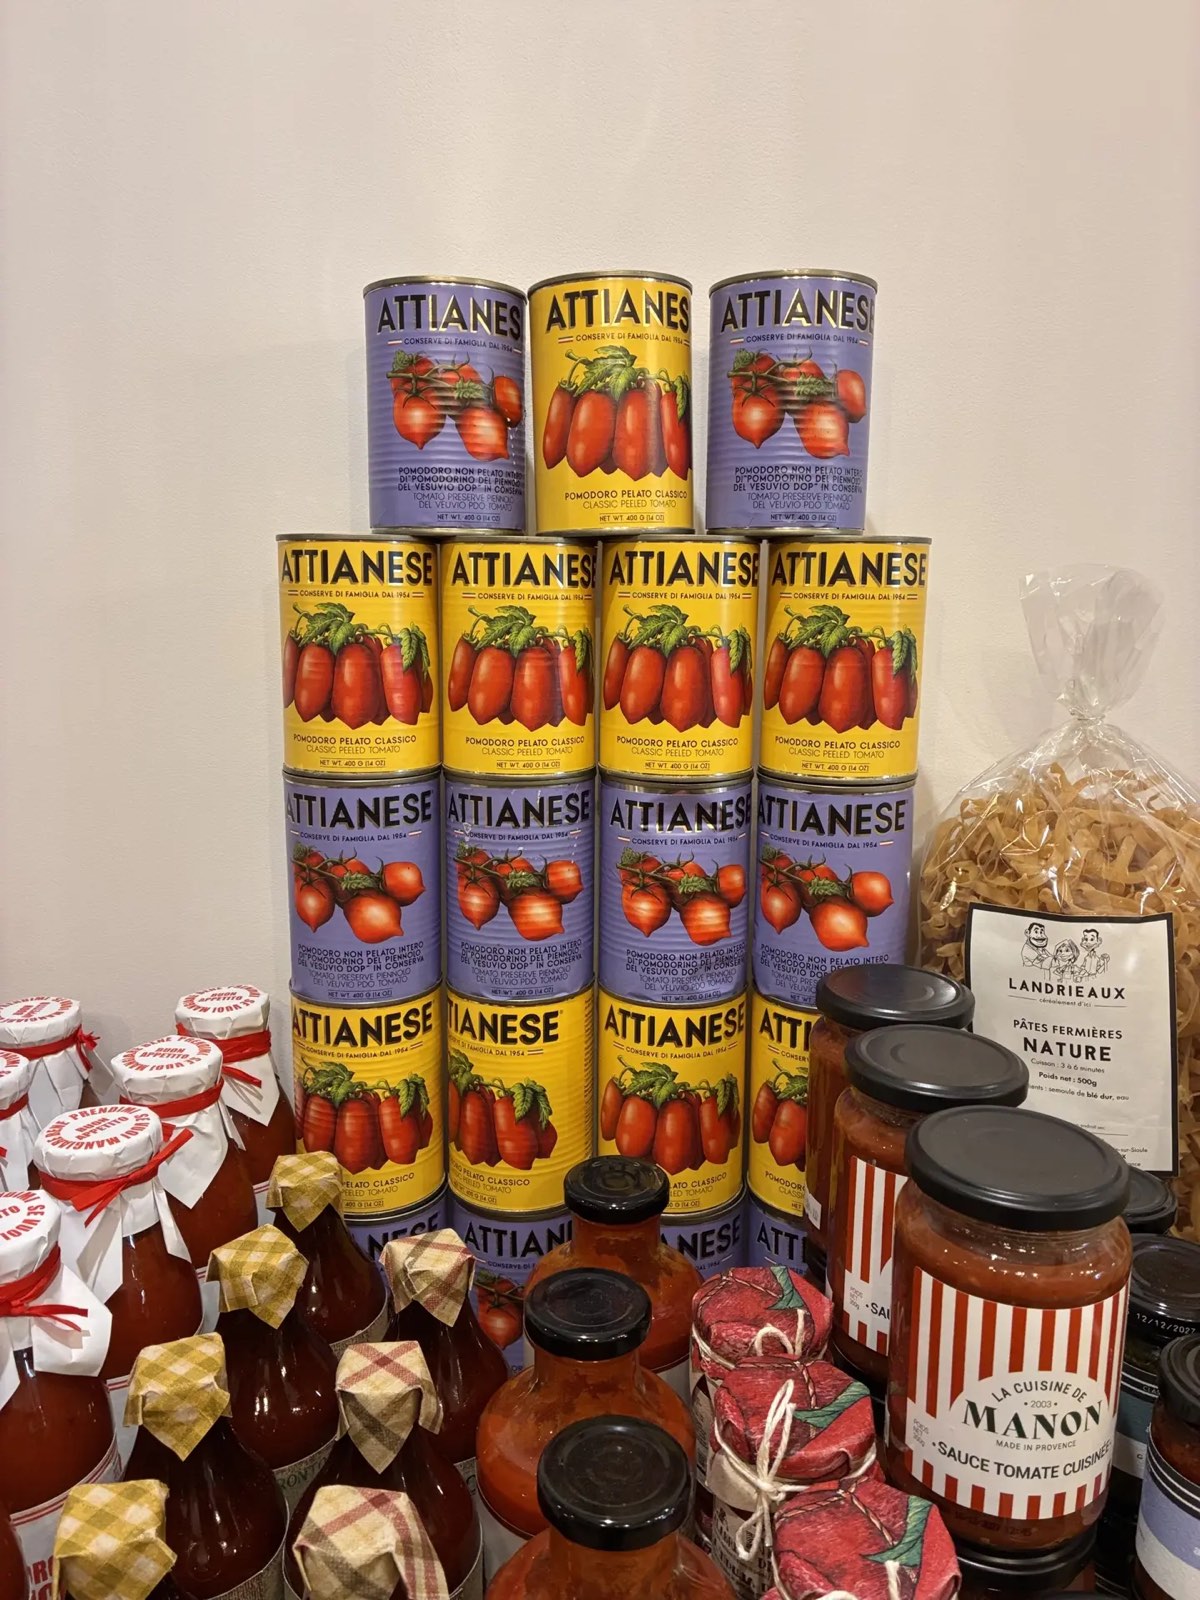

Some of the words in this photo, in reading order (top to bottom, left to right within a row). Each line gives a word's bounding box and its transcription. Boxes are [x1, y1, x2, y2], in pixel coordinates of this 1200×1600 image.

[377, 294, 522, 340] ATTIANES
[545, 288, 690, 334] ATTIANES
[576, 332, 615, 342] CONSERVE
[618, 332, 626, 340] DI
[627, 332, 659, 341] FAMIGLIA
[735, 465, 788, 475] POMODORO
[792, 466, 812, 474] NON
[815, 466, 843, 476] PELATO
[565, 490, 618, 500] POMODORO
[621, 490, 652, 499] PELATO
[655, 490, 688, 500] CLASSICO
[583, 500, 618, 510] CLASSIC
[620, 500, 647, 509] PEELED
[650, 500, 677, 509] TOMATO
[281, 549, 432, 587] ATTIANESE
[608, 550, 759, 588] ATTIANESE
[770, 551, 926, 588] ATTIANESE
[299, 590, 332, 598] CONSERVE
[478, 592, 515, 600] CONSERVE
[632, 592, 668, 600] CONSERVE
[680, 592, 713, 600] FAMIGLIA
[794, 592, 829, 600] CONSERVE
[832, 592, 840, 600] DI
[294, 733, 337, 745] POMODORO
[340, 737, 371, 746] PELATO
[375, 734, 417, 745] CLASSICO
[466, 736, 515, 748] POMODORO
[518, 740, 549, 748] PELATO
[551, 736, 585, 746] CLASSICO
[616, 736, 663, 747] POMODORO
[666, 740, 698, 748] PELATO
[700, 738, 739, 748] CLASSICO
[775, 736, 821, 748] POMODORO
[824, 740, 856, 750] PELATO
[860, 740, 901, 750] CLASSICO
[631, 746, 663, 756] CLASSIC
[666, 748, 692, 758] PEELED
[695, 748, 724, 756] TOMATO
[287, 789, 433, 830] ATTIANESE
[448, 789, 591, 829] ATTIANESE
[757, 793, 907, 837] ATTIANESE
[300, 832, 330, 842] CONSERVE
[393, 832, 407, 840] 1954
[770, 834, 800, 846] CONSERVE
[760, 944, 805, 962] POMODORO
[808, 956, 827, 965] NON
[830, 957, 861, 966] PELATO
[863, 954, 889, 964] INTERO
[1008, 977, 1126, 1000] LANDRIEAUX
[292, 1000, 433, 1048] ATTIANESE
[447, 1000, 560, 1045] IANESE
[604, 1001, 745, 1048] ATTIANESE
[760, 1008, 812, 1052] ATTI
[1013, 1018, 1049, 1034] PÂTES
[1052, 1025, 1123, 1040] FERMIÈRES
[626, 1046, 659, 1058] CONSERVE
[1023, 1036, 1112, 1062] NATURE
[149, 1062, 184, 1072] VUOI
[1030, 1058, 1056, 1068] Cuisson
[1080, 1066, 1105, 1074] minutes
[1038, 1072, 1058, 1080] Poids
[1077, 1077, 1097, 1087] 500g
[1048, 1087, 1075, 1096] semoule
[1086, 1090, 1098, 1098] blé
[68, 1106, 142, 1121] PRENDIMI
[75, 1117, 110, 1132] BUON
[75, 1116, 129, 1140] APPETITO
[120, 1122, 150, 1140] VUOI
[0, 1219, 41, 1240] VUOI
[661, 1214, 741, 1261] NESE
[1136, 1312, 1196, 1335] 12/12/2027
[992, 1387, 1012, 1402] LA
[1013, 1380, 1072, 1395] CUISINE
[1072, 1387, 1087, 1403] DE
[1030, 1400, 1052, 1409] 2003
[962, 1399, 1103, 1440] MANON
[996, 1440, 1021, 1450] MADE
[1036, 1440, 1077, 1452] PROVENCE
[938, 1440, 990, 1472] SAUCE
[994, 1461, 1060, 1480] TOMATE
